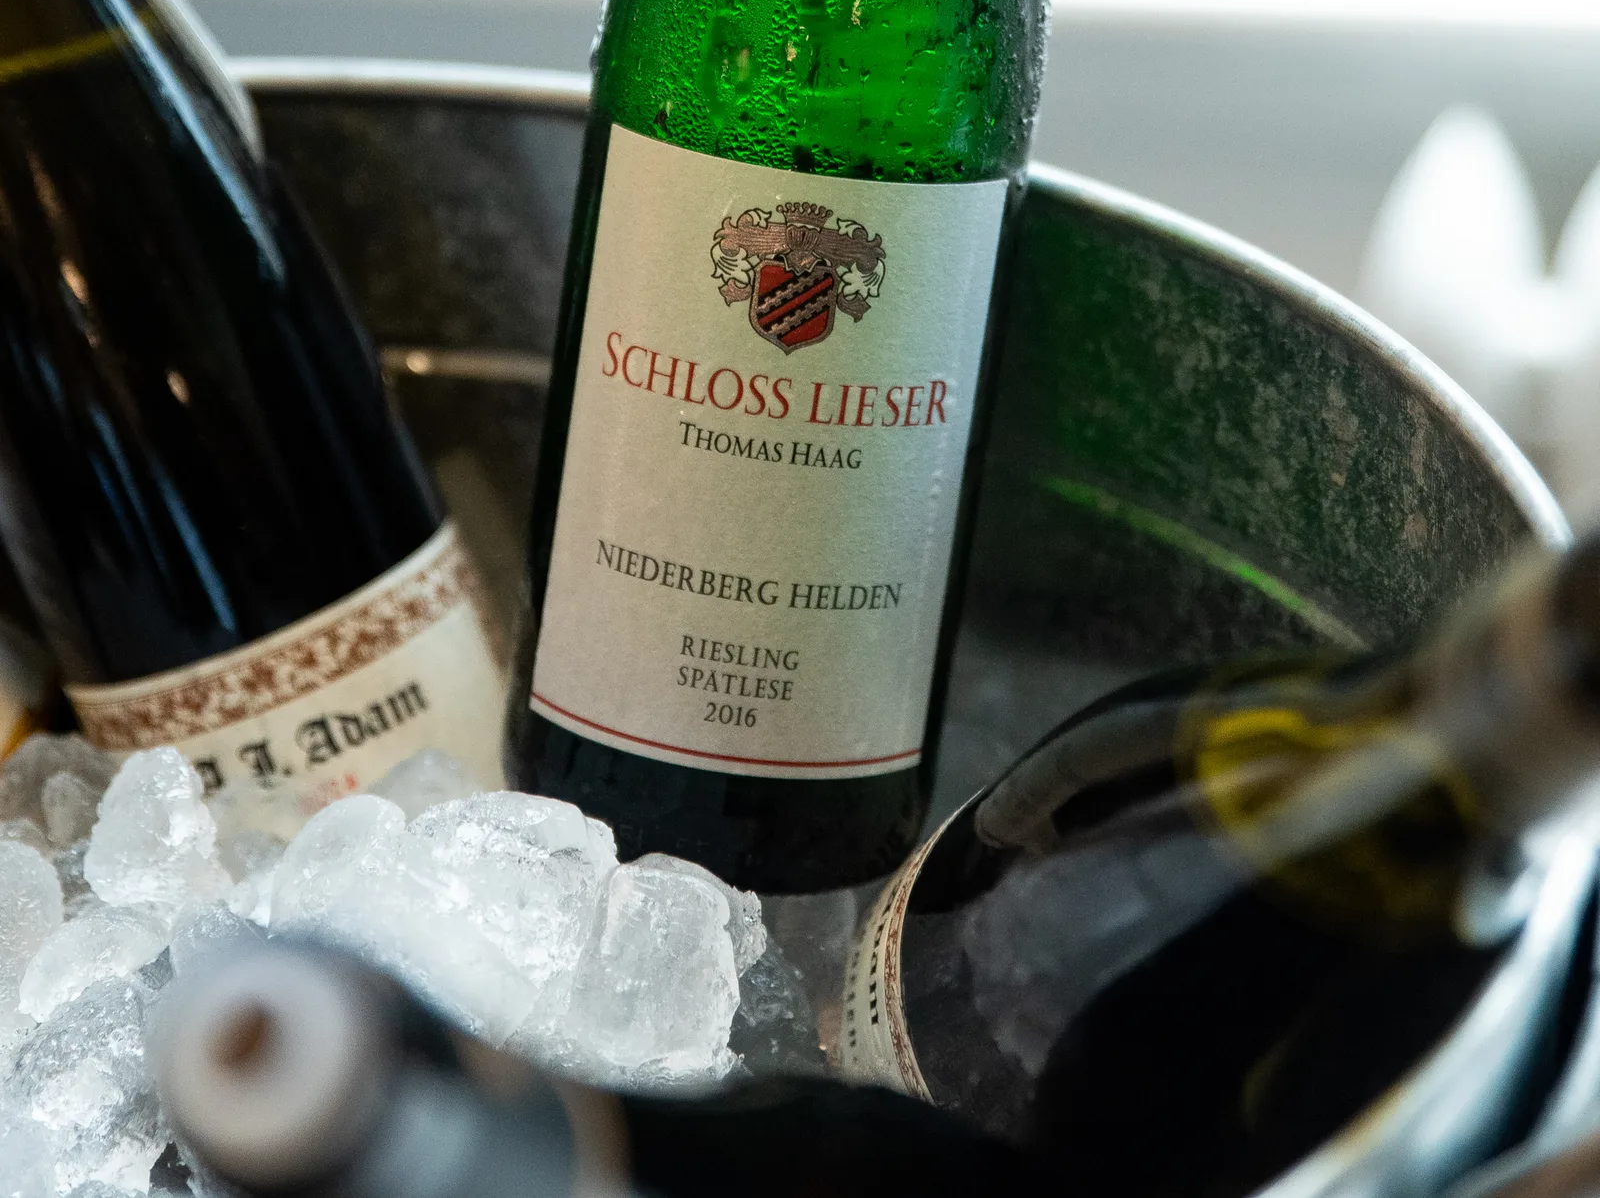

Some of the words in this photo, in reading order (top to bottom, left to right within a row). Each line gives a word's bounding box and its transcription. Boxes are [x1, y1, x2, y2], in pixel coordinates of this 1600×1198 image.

[602, 332, 792, 419] SCHLOSS
[806, 380, 947, 427] LIESER
[679, 421, 783, 463] THOMAS
[789, 442, 863, 470] HAAG
[596, 539, 779, 606] NIEDERBERG
[788, 582, 903, 611] HELDEN
[680, 635, 799, 671] RIESLING
[677, 666, 794, 701] SPÄTLESE
[297, 681, 427, 765] Adam
[703, 702, 758, 728] 2016
